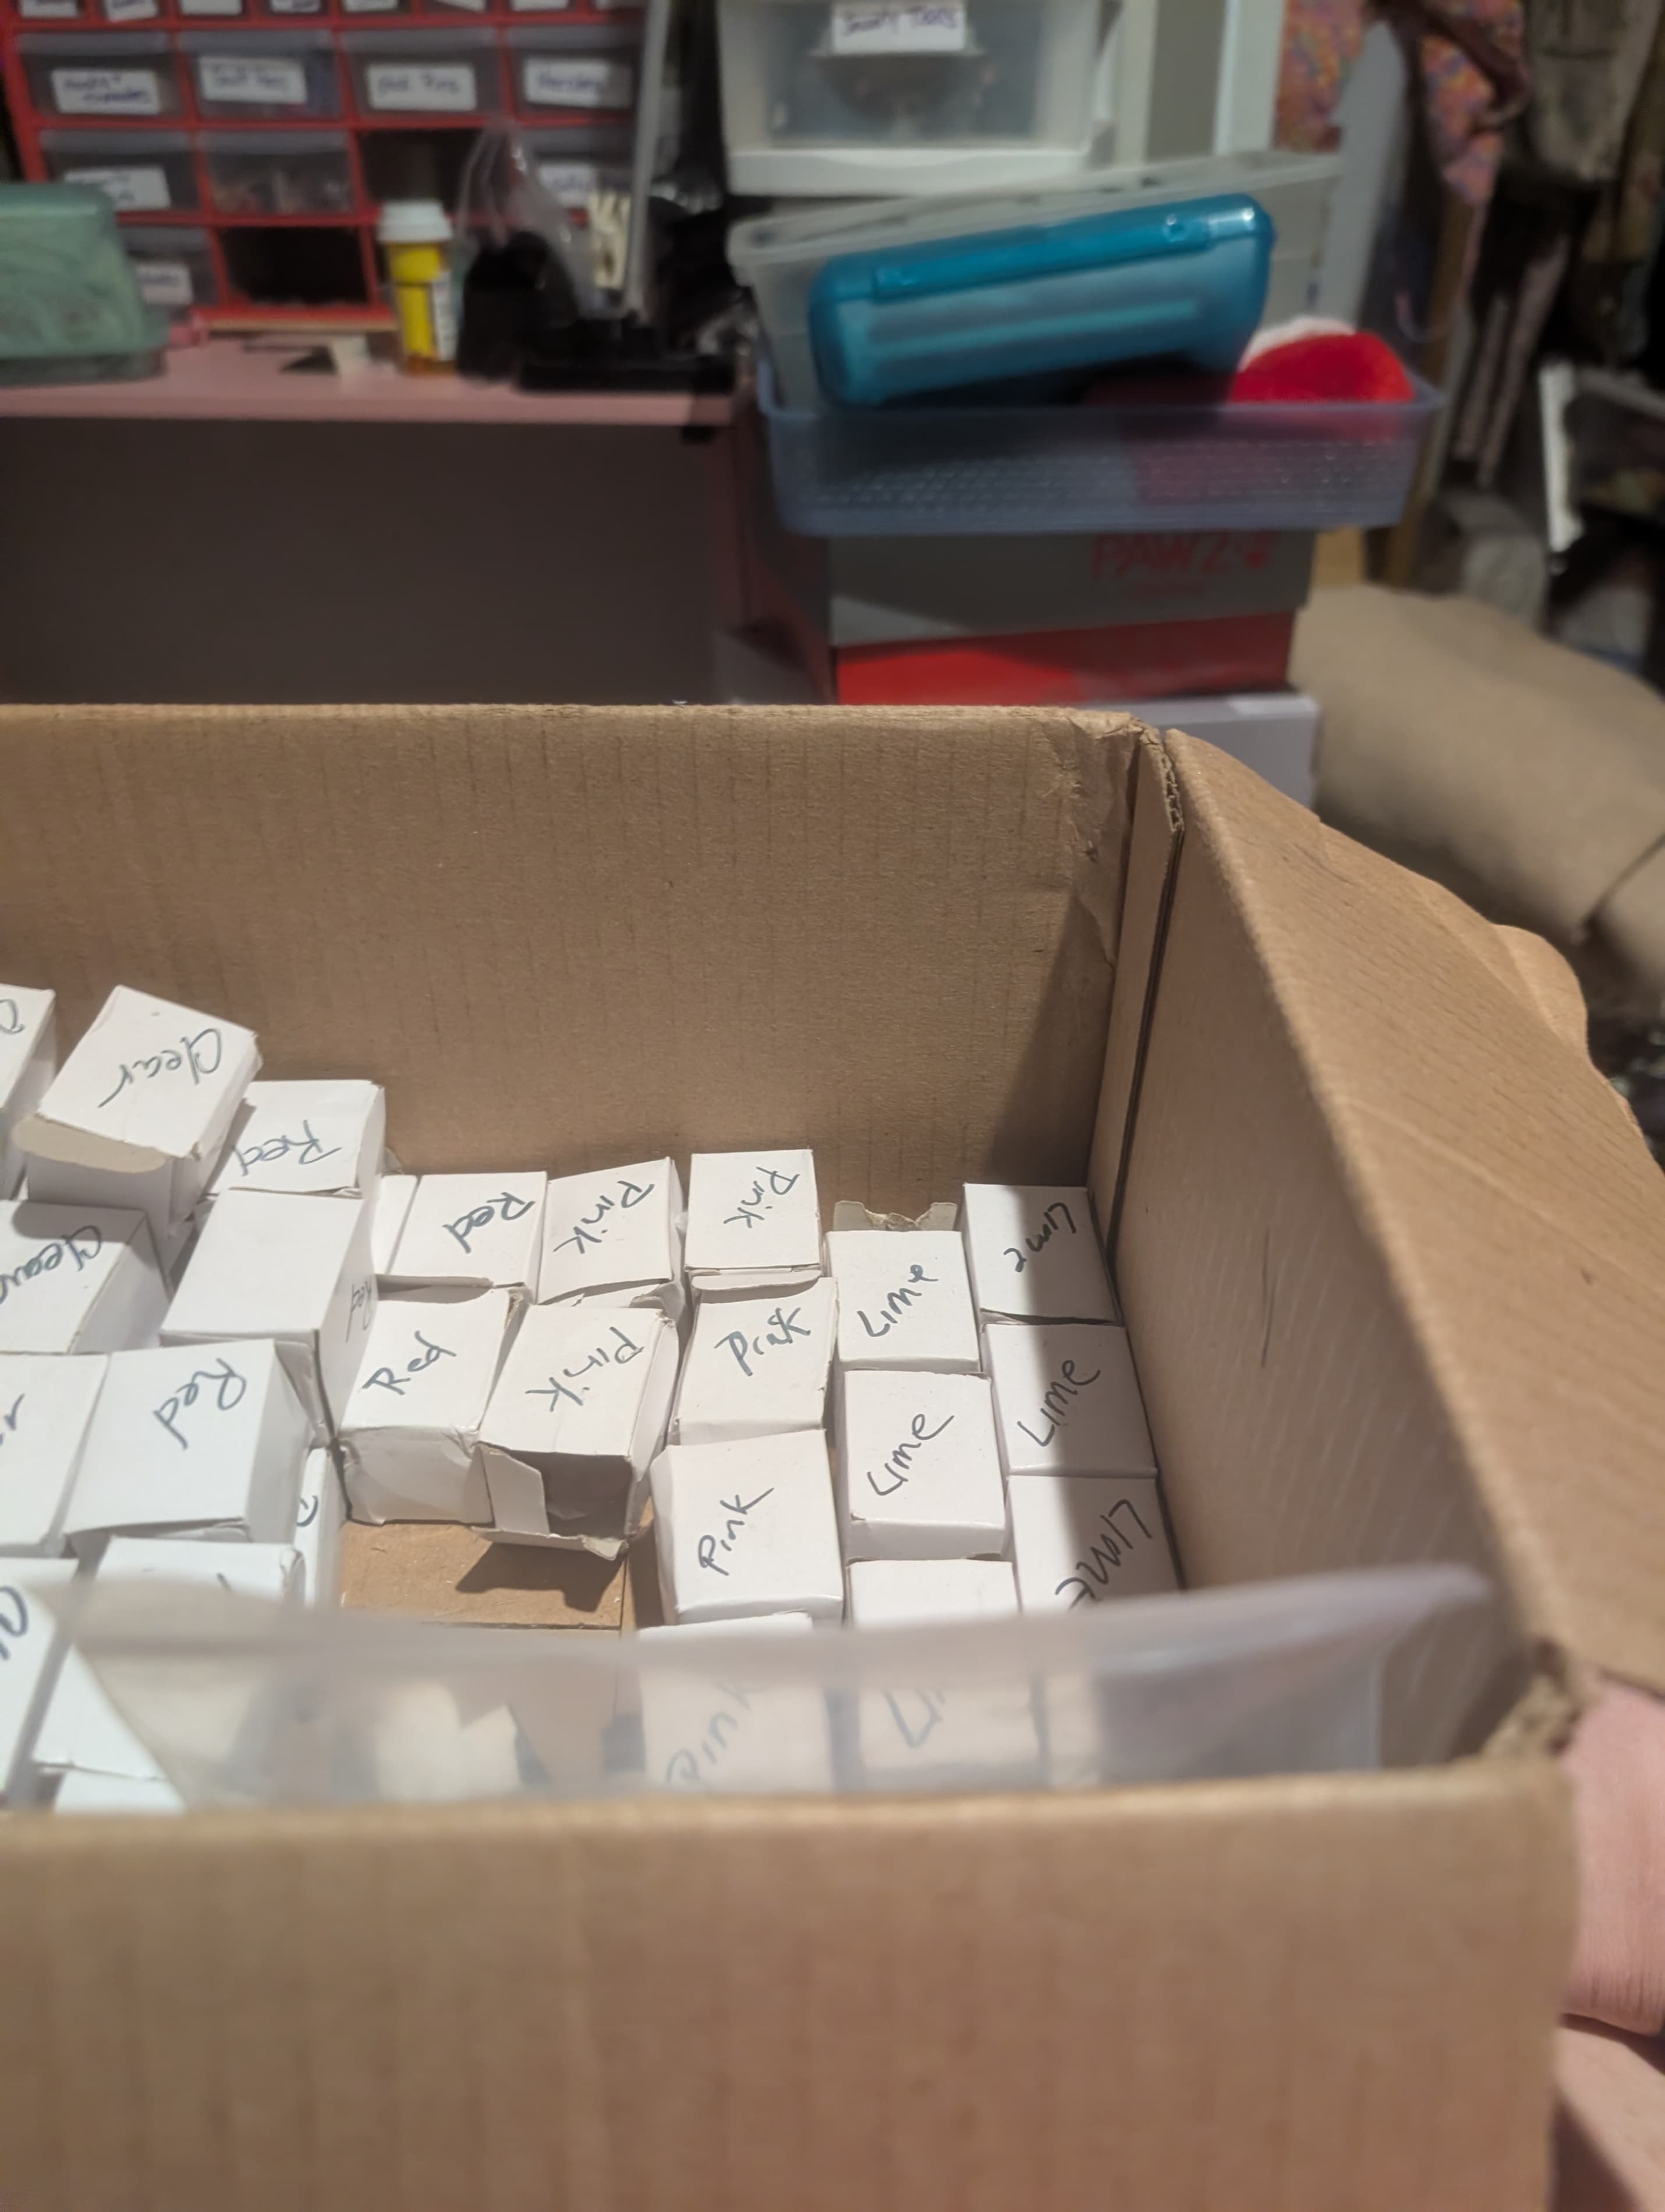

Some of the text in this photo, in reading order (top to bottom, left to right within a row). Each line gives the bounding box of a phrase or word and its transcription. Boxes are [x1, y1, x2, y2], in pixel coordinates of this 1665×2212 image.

[97, 1027, 223, 1109] Clear
[232, 1119, 342, 1177] Red
[442, 1191, 537, 1254] Red
[360, 1330, 458, 1396] Red
[152, 1357, 247, 1451] Red
